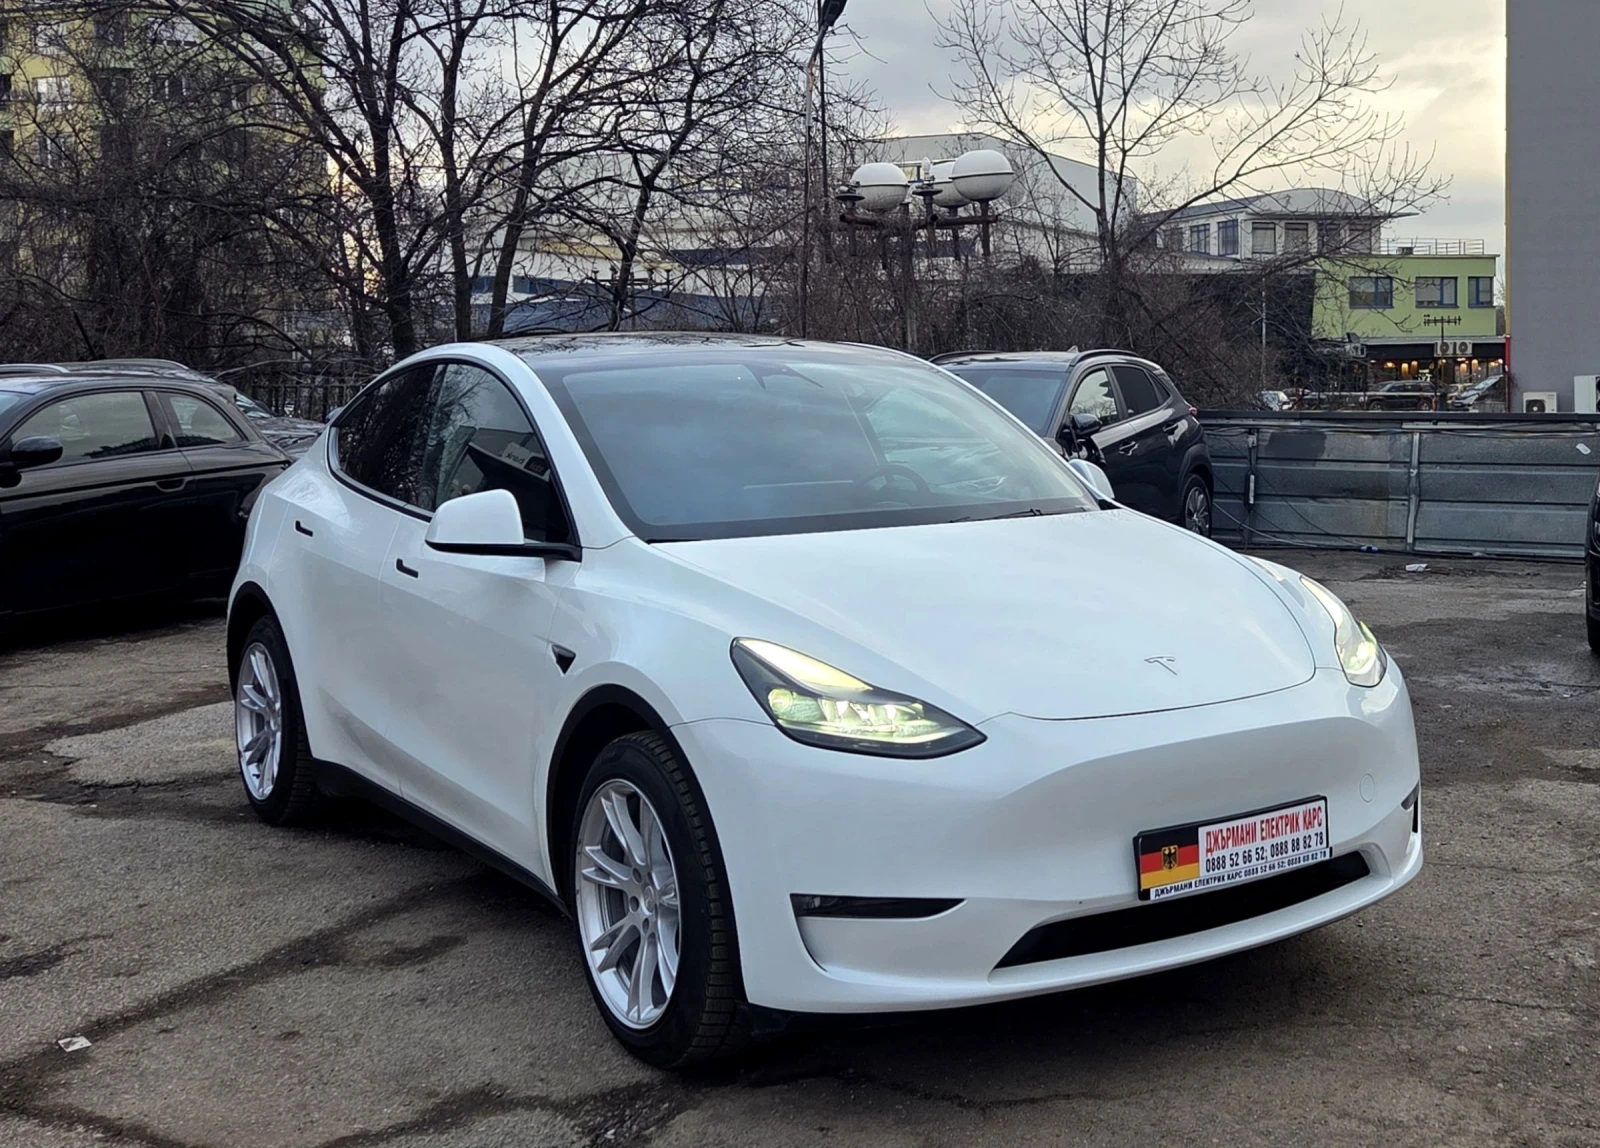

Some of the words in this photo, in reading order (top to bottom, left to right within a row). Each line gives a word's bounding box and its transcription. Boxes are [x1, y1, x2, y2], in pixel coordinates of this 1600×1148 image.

[1205, 855, 1226, 873] 0888
[1229, 852, 1239, 868] 52
[1242, 849, 1252, 865] 66
[1270, 840, 1288, 858] 0888
[1291, 837, 1300, 853] 88
[1302, 834, 1312, 849] 82
[1314, 831, 1323, 847] 78
[1206, 821, 1256, 856] ДЖЪРМАНИ
[1260, 811, 1300, 841] ЕЛЕКТРИК
[1303, 806, 1322, 830] КАРС
[1154, 880, 1192, 898] ДЖЪРМАНИ
[1194, 874, 1225, 888] ЕЛЕКТРИК
[1227, 870, 1242, 881] КАРС
[1244, 866, 1258, 877] 0888
[1260, 864, 1267, 873] 52
[1287, 856, 1301, 866] 0888
